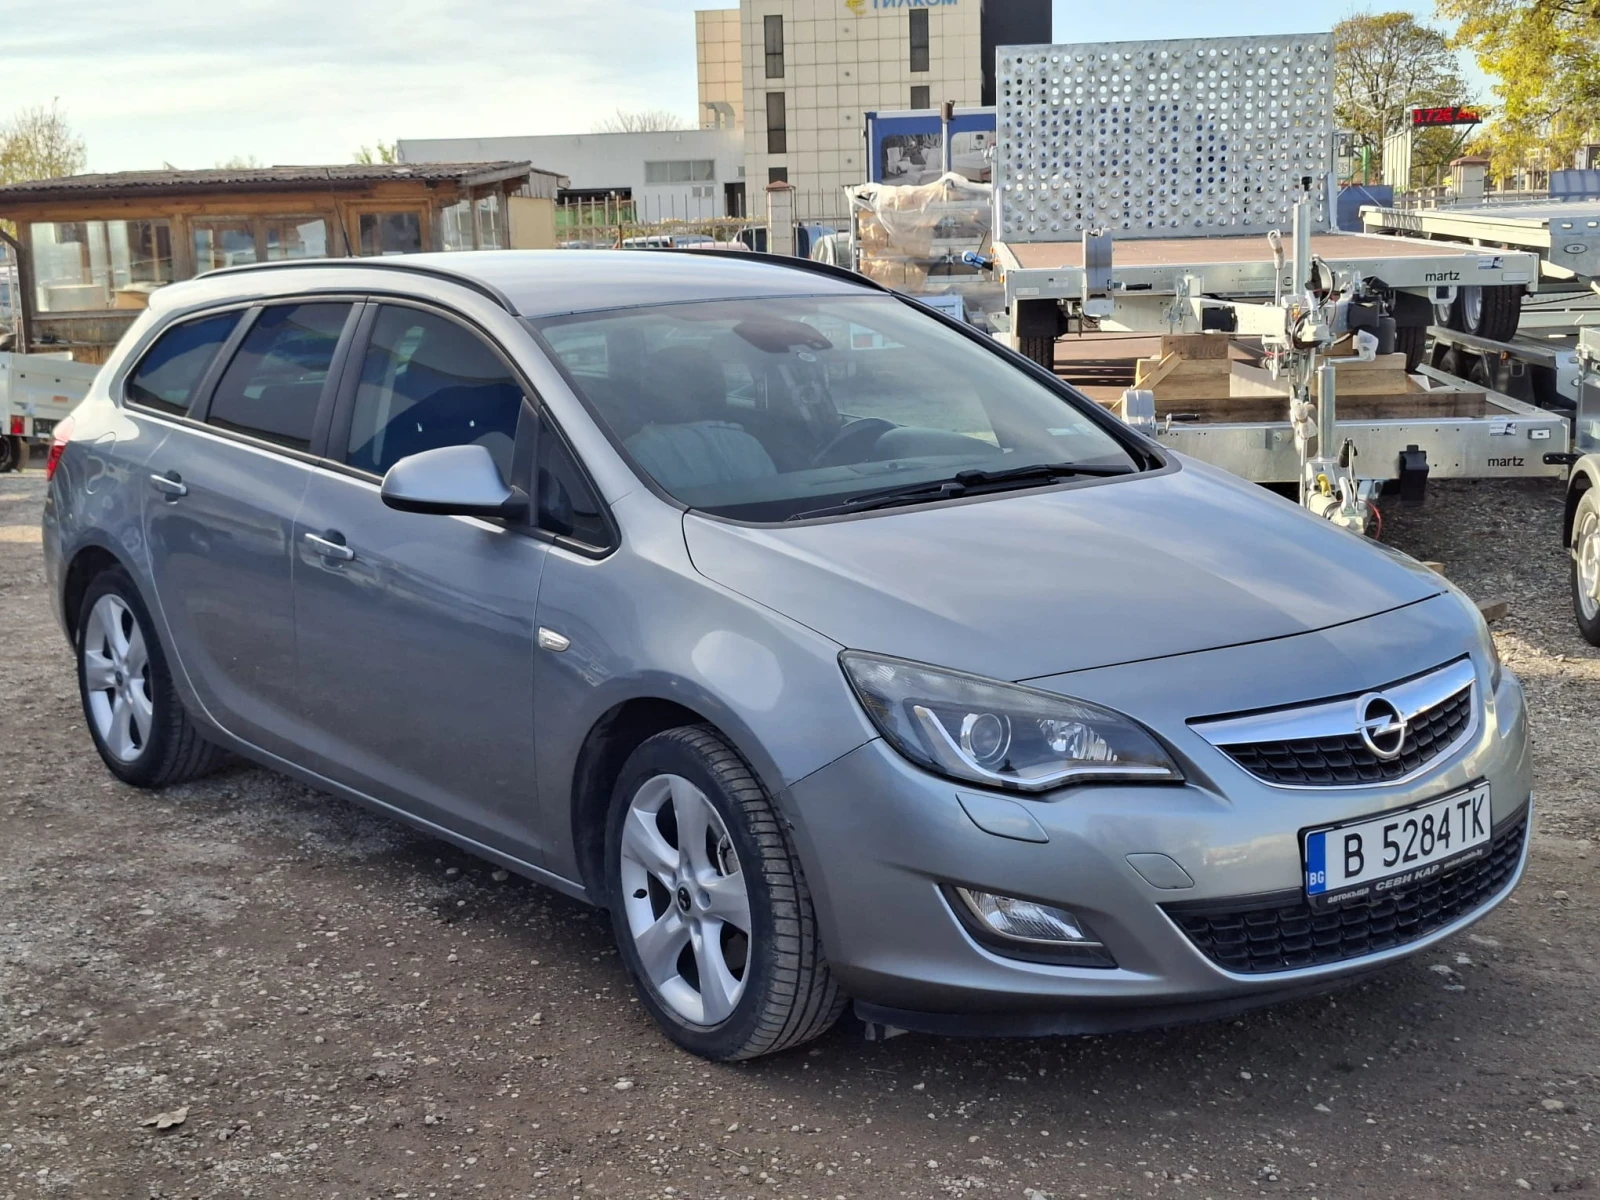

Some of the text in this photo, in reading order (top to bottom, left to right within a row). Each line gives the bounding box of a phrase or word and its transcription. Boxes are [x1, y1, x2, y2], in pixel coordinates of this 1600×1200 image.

[1425, 270, 1460, 282] martz
[1488, 456, 1525, 467] martz
[1344, 794, 1485, 879] B 5284 TK
[1309, 871, 1325, 886] BG
[1375, 874, 1413, 891] СЕВИ
[1414, 864, 1440, 880] КАР
